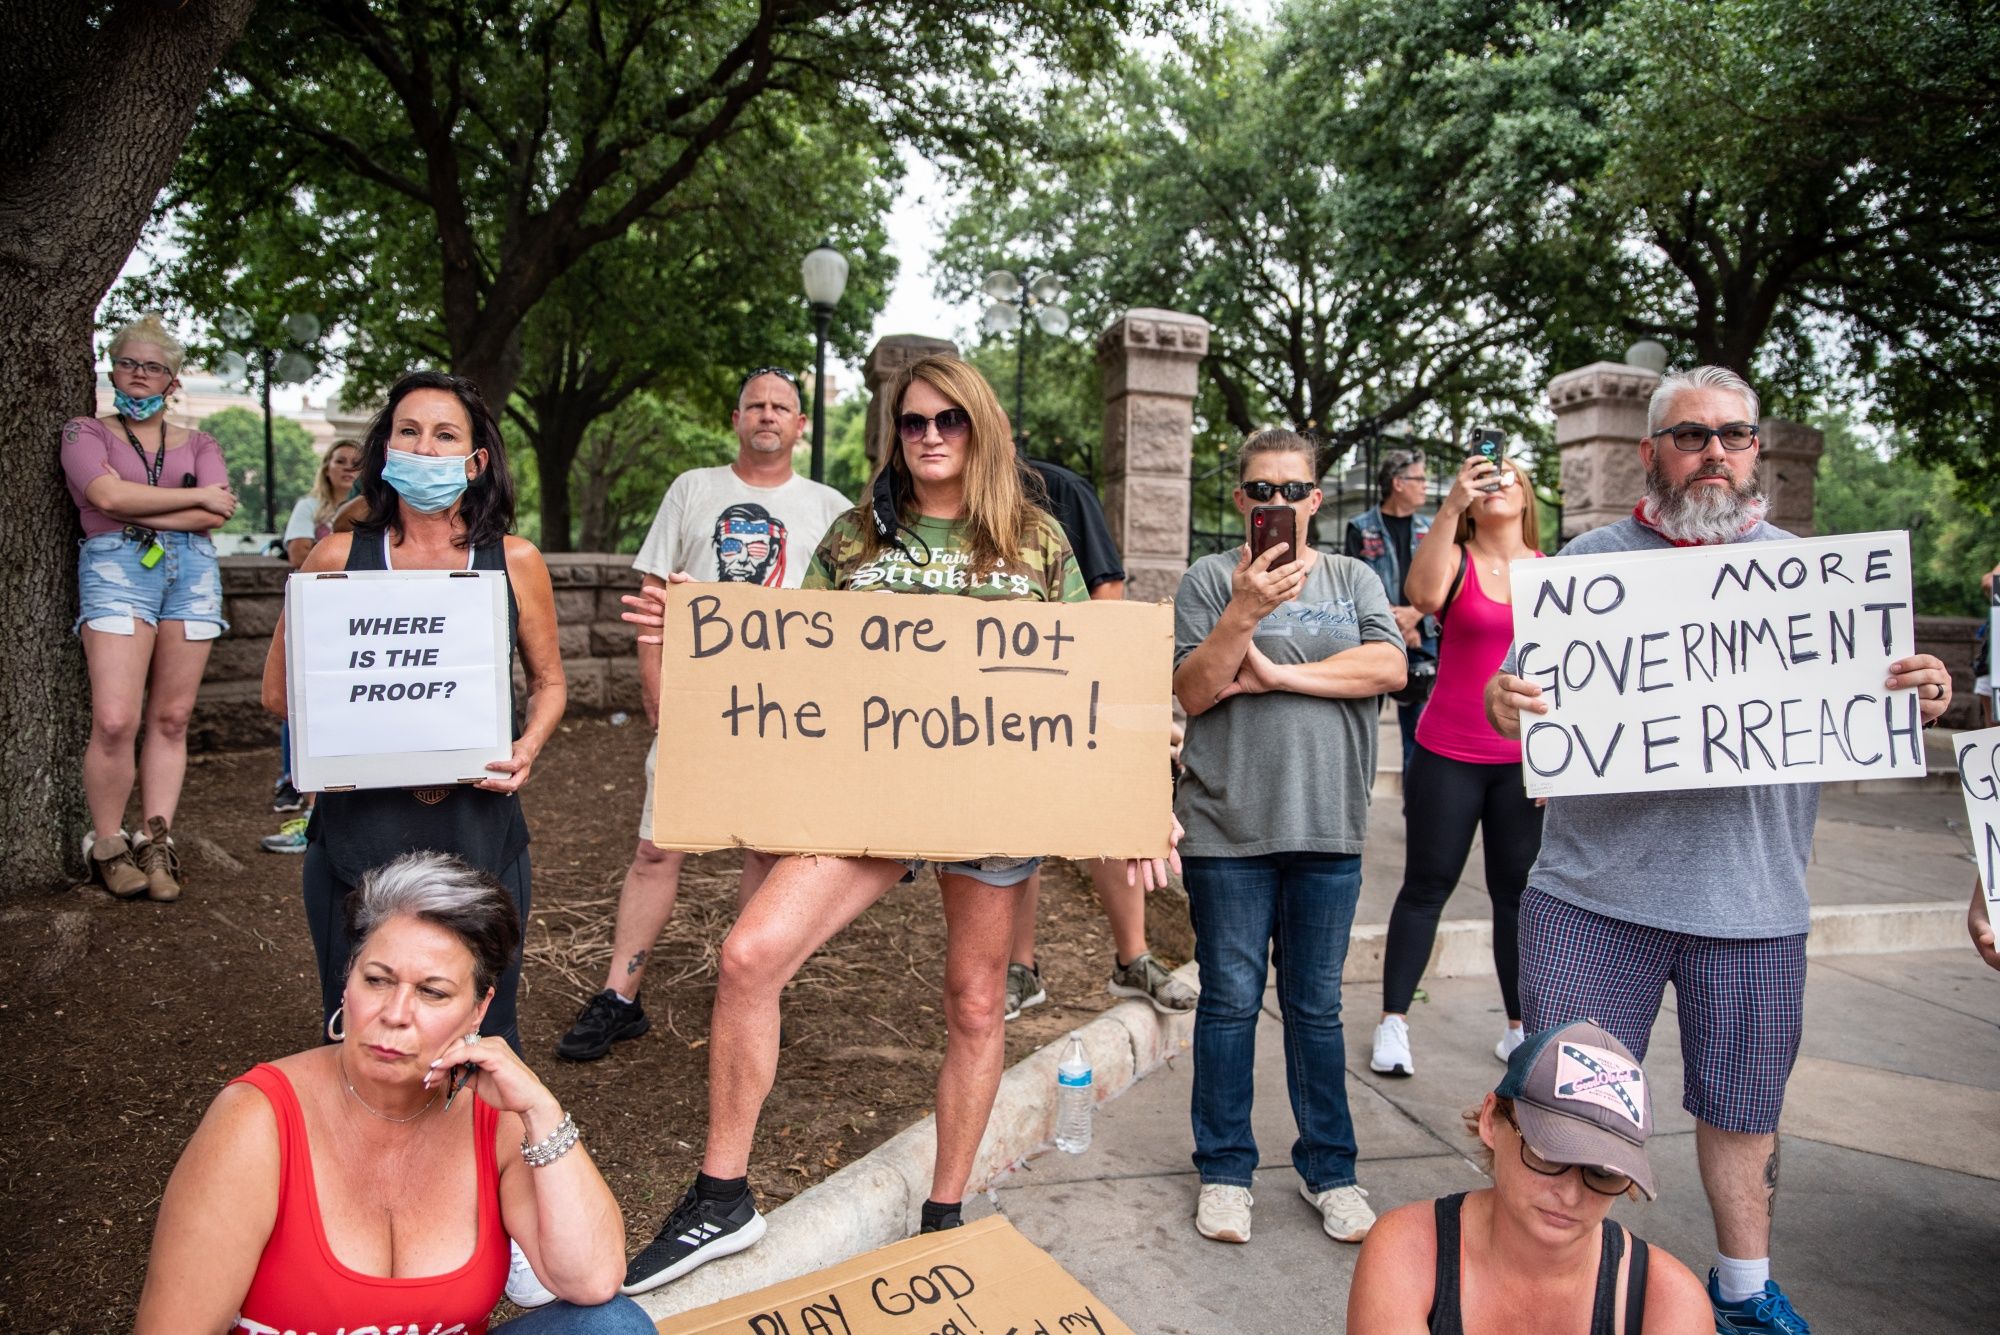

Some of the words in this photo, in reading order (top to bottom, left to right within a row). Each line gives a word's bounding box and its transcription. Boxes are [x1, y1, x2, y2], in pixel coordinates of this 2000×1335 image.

[1533, 573, 1626, 618] NO
[1711, 549, 1893, 601] MORE
[349, 616, 446, 636] WHERE
[688, 595, 834, 659] Bars
[861, 614, 947, 653] are
[976, 616, 1075, 661] not
[349, 650, 376, 669] IS
[385, 648, 440, 667] THE
[1517, 602, 1908, 710] GOVERNMENT
[349, 681, 457, 703] PROOF?
[721, 682, 827, 740] the
[1526, 692, 1922, 778] OVERREACH
[871, 1264, 975, 1316] GOD
